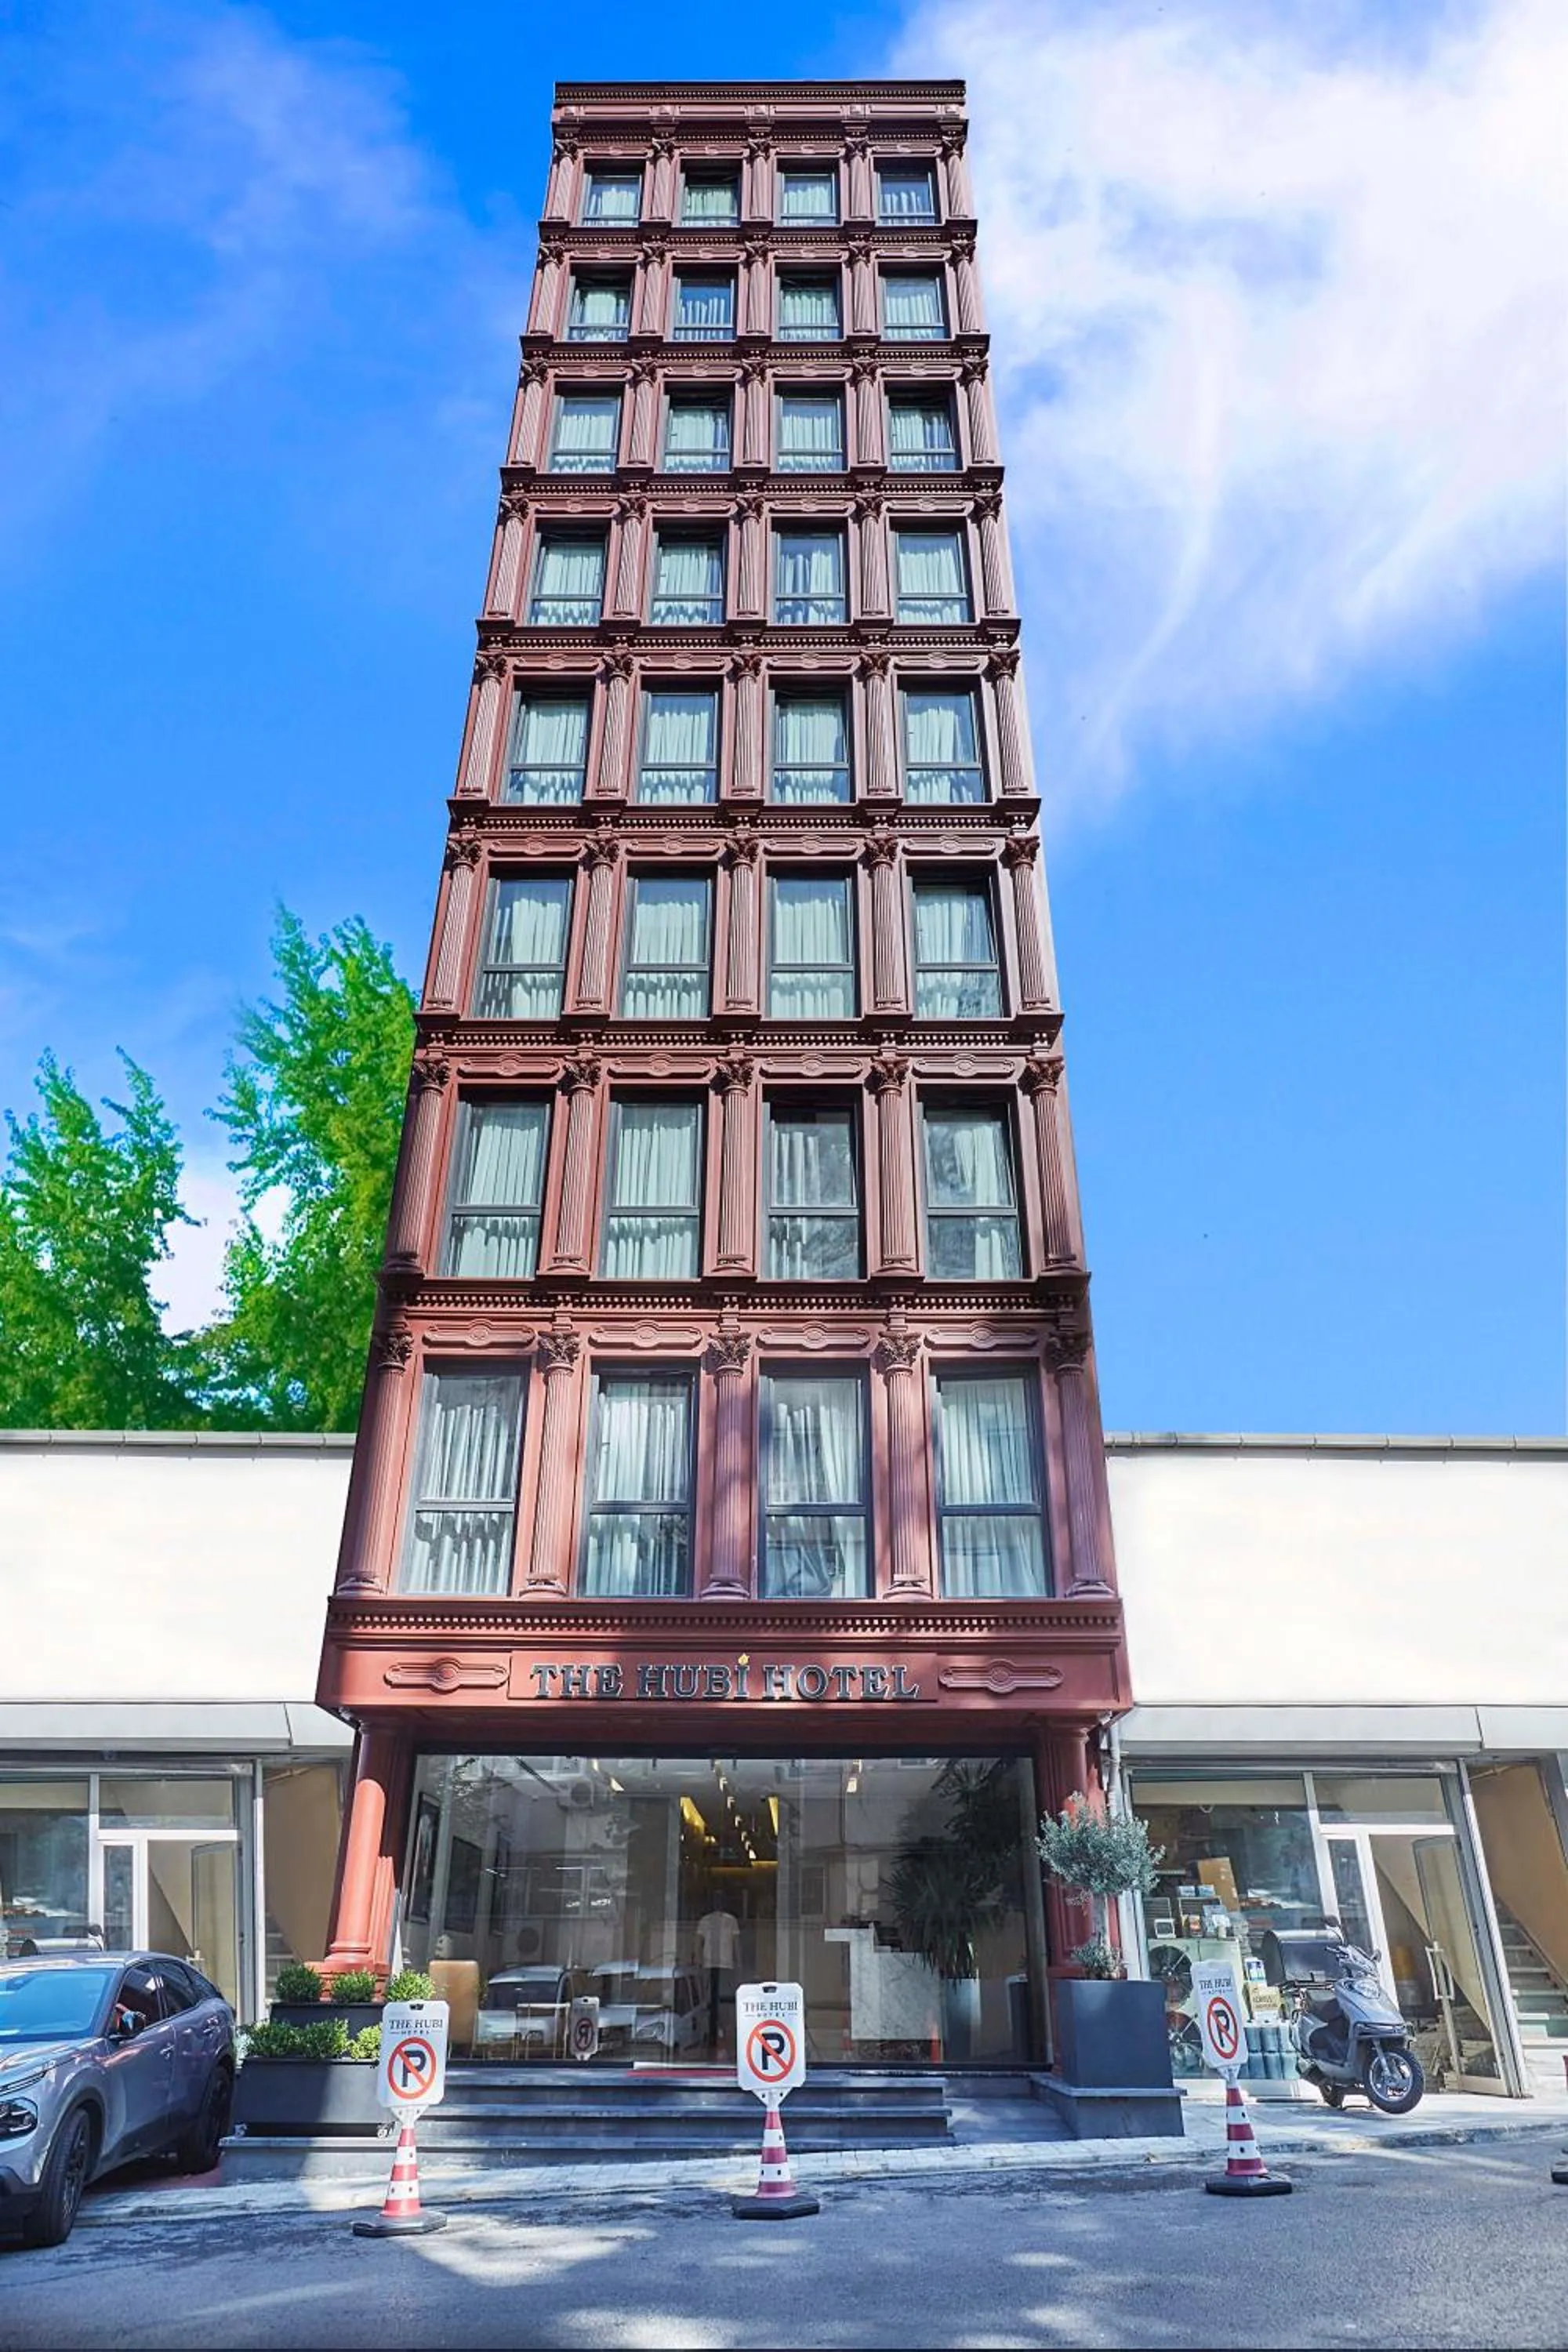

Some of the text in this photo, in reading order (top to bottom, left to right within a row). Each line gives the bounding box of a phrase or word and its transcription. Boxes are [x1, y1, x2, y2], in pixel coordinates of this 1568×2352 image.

[530, 1663, 623, 1698] THE
[762, 1664, 919, 1700] HOTEL
[743, 2002, 768, 2012] THE
[389, 2019, 412, 2029] THE
